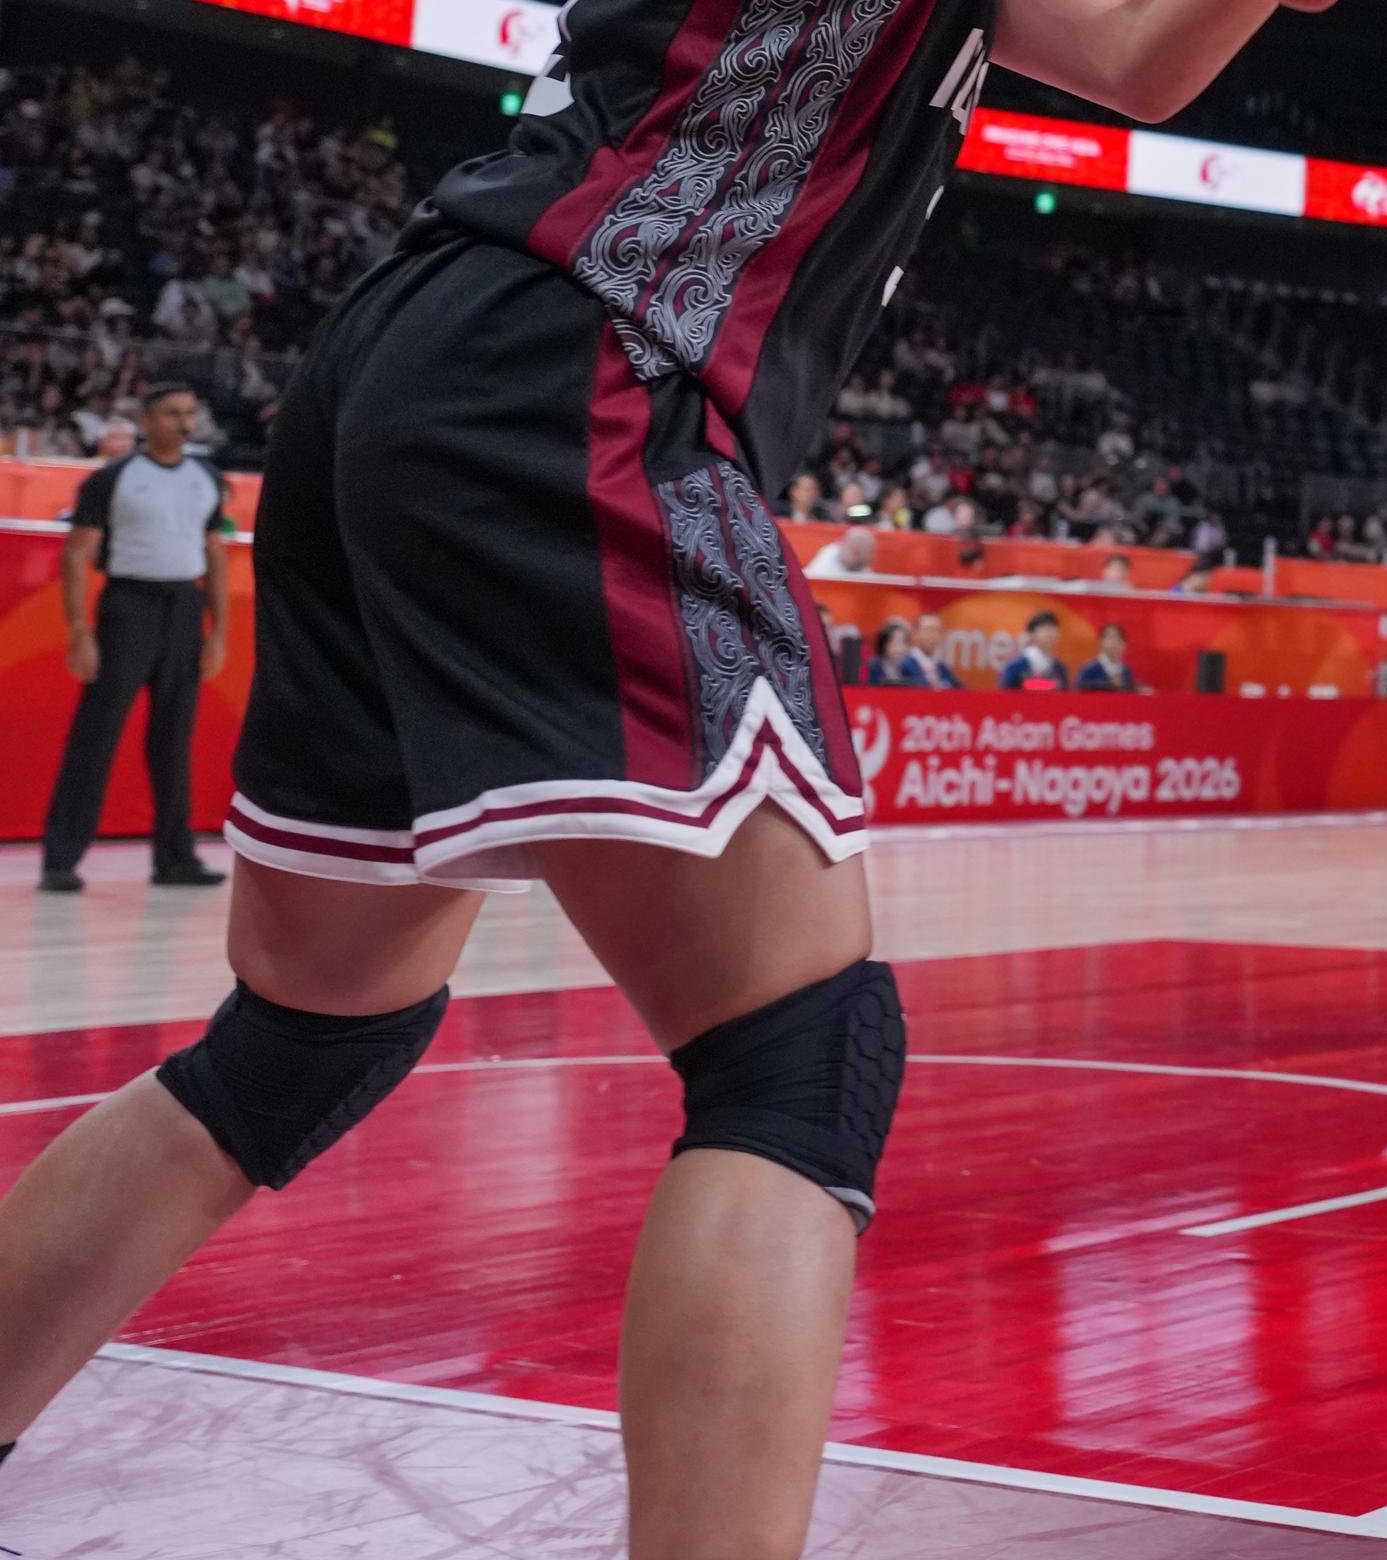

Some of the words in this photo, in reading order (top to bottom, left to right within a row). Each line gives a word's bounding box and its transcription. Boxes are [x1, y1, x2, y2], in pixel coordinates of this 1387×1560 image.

[902, 716, 971, 752] 20th
[978, 714, 1054, 751] Asian
[1059, 716, 1154, 751] Games
[896, 756, 1151, 817] Aichi-Nagoya
[1155, 757, 1241, 801] 2026
